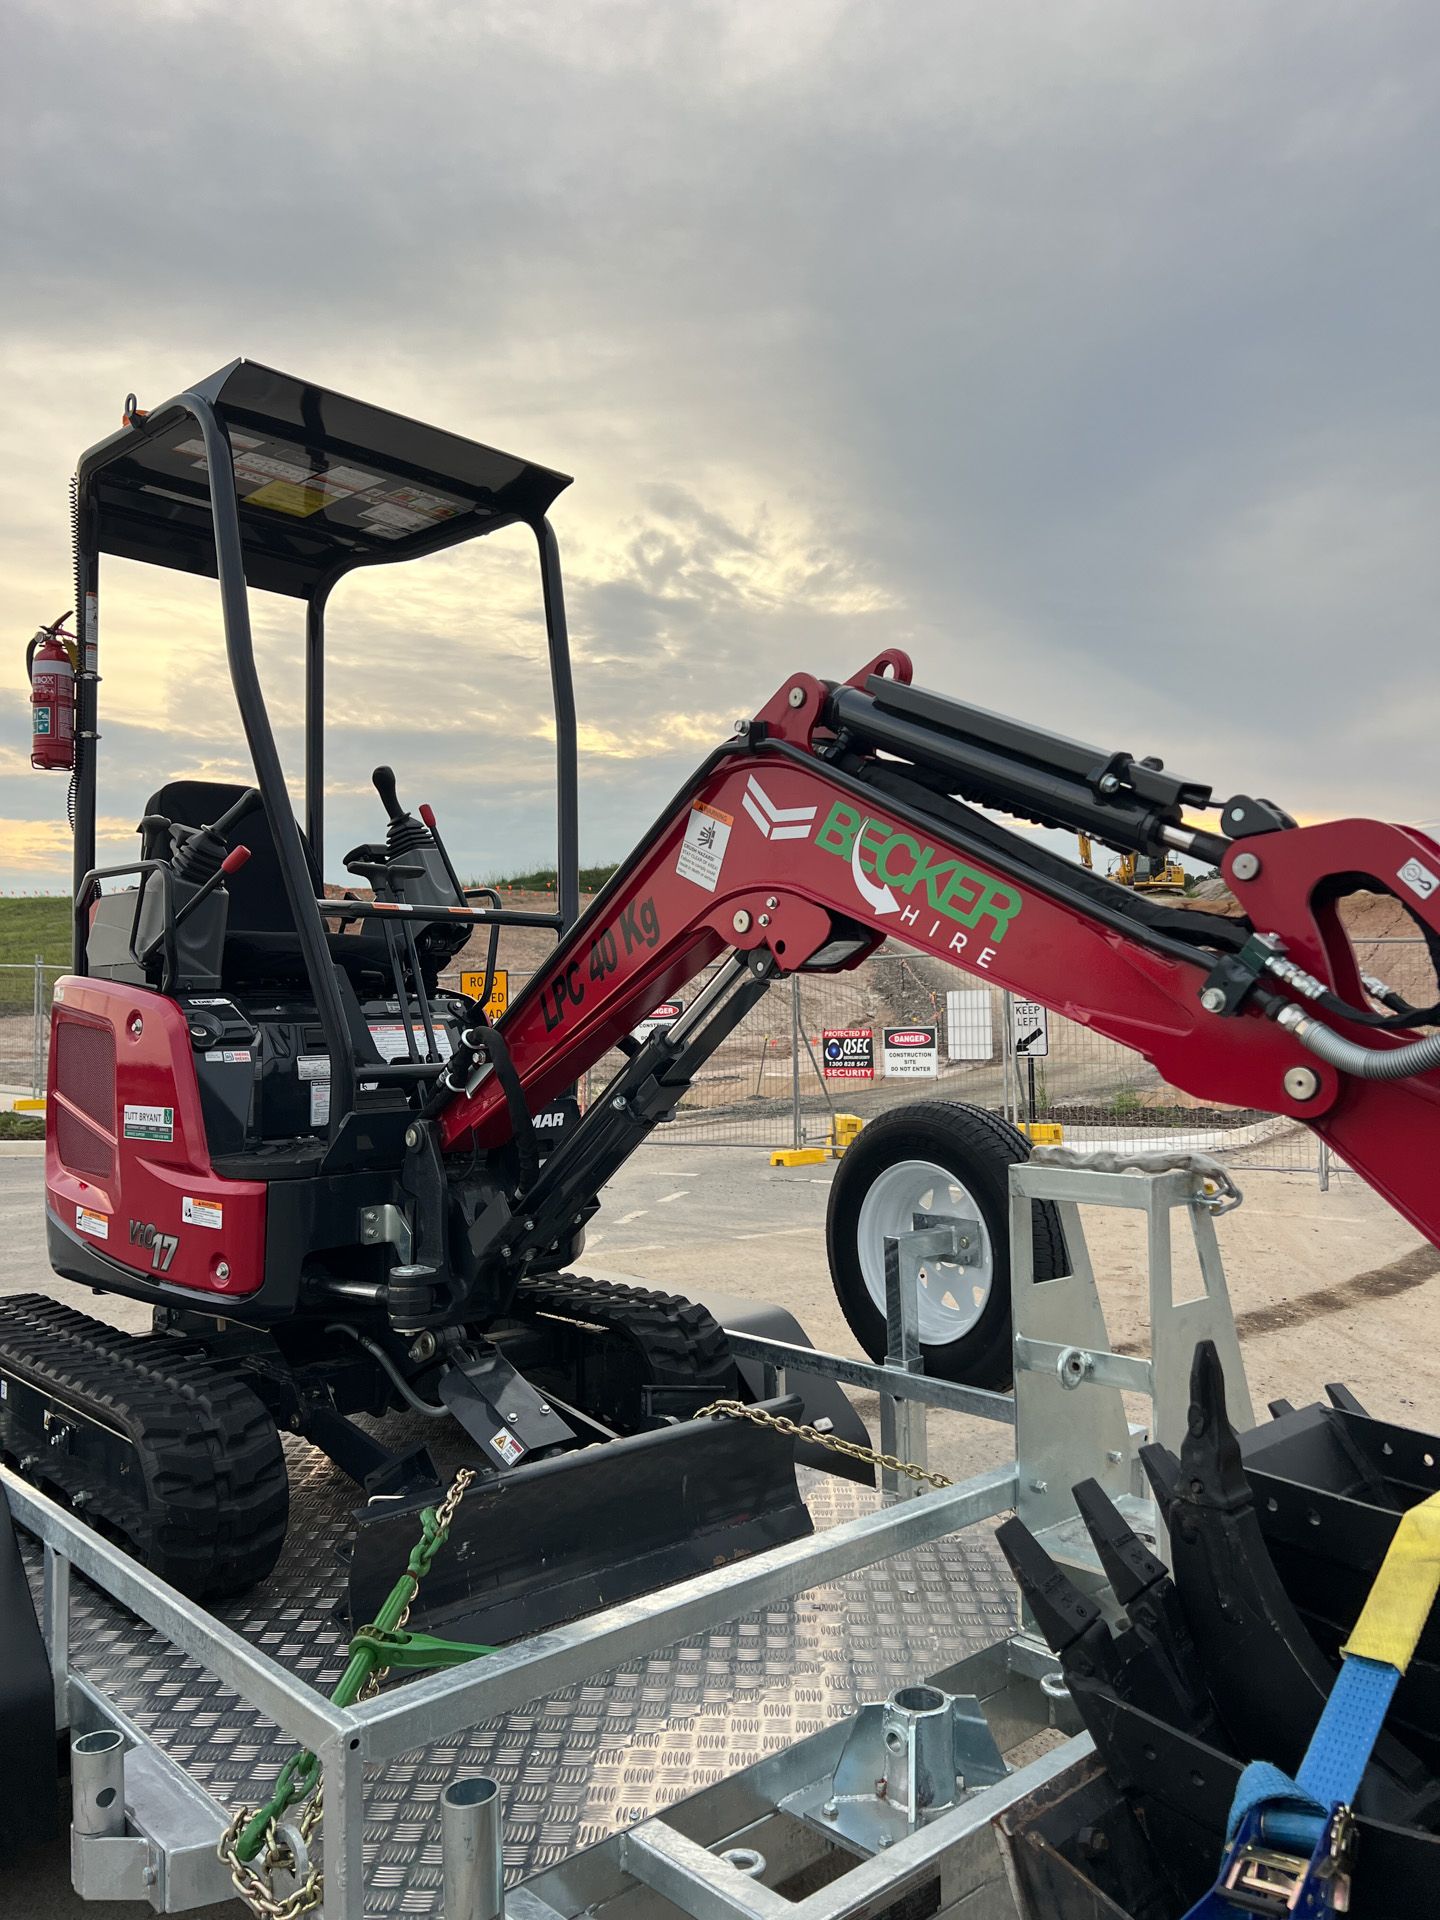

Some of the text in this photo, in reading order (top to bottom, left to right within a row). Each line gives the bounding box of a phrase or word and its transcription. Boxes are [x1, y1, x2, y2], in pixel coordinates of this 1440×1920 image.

[814, 800, 1023, 943] BECKER
[900, 904, 996, 968] HIRE
[541, 896, 660, 1033] LPC 40 Kg
[470, 976, 498, 987] ROD
[1015, 1005, 1041, 1014] KEEP
[1017, 1017, 1039, 1026] LEFT
[894, 1035, 925, 1043] DANGER
[843, 1038, 870, 1055] QSEC
[826, 1069, 872, 1077] SECURITY
[125, 1111, 162, 1122] TUTT BRYANT
